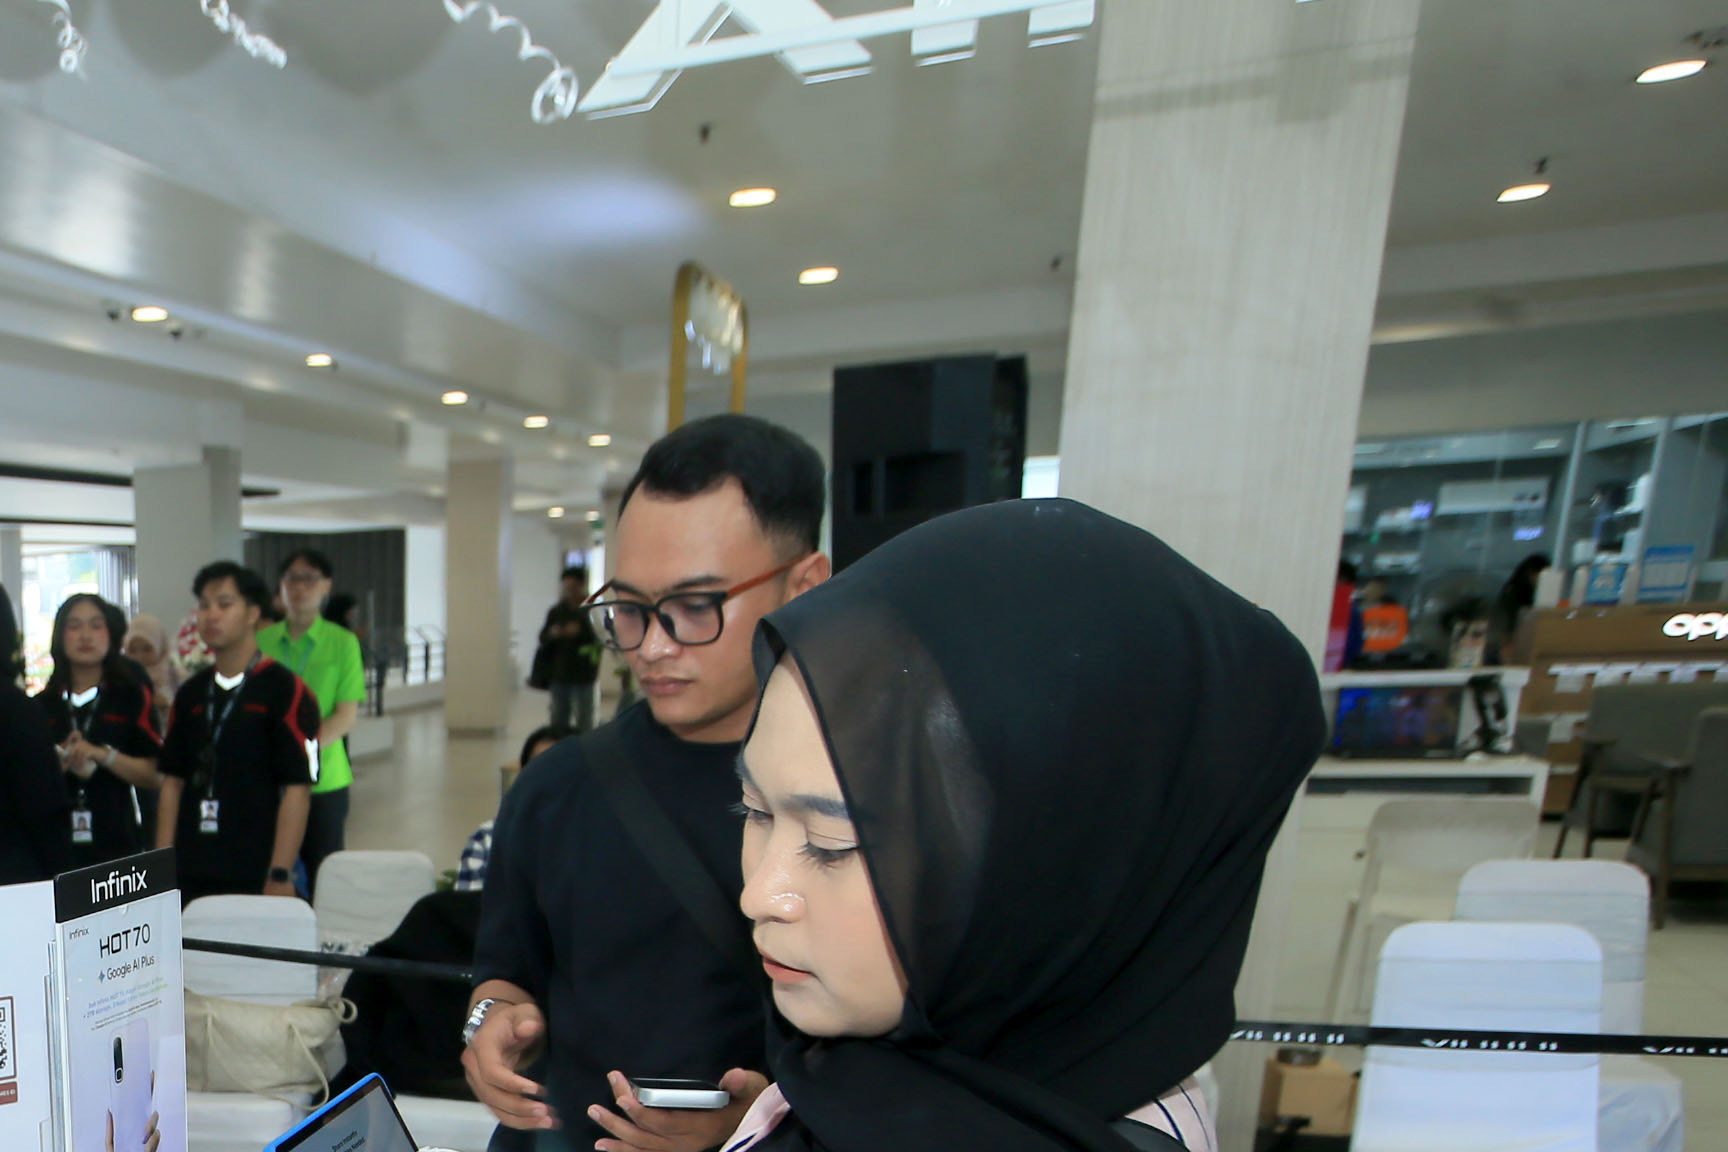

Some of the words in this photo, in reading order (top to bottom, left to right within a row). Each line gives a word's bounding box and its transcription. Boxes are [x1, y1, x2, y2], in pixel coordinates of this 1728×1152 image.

[91, 866, 148, 904] Infinix
[69, 927, 90, 940] Infinix
[106, 962, 132, 981] Google
[133, 958, 141, 971] AI
[141, 955, 155, 968] Plus
